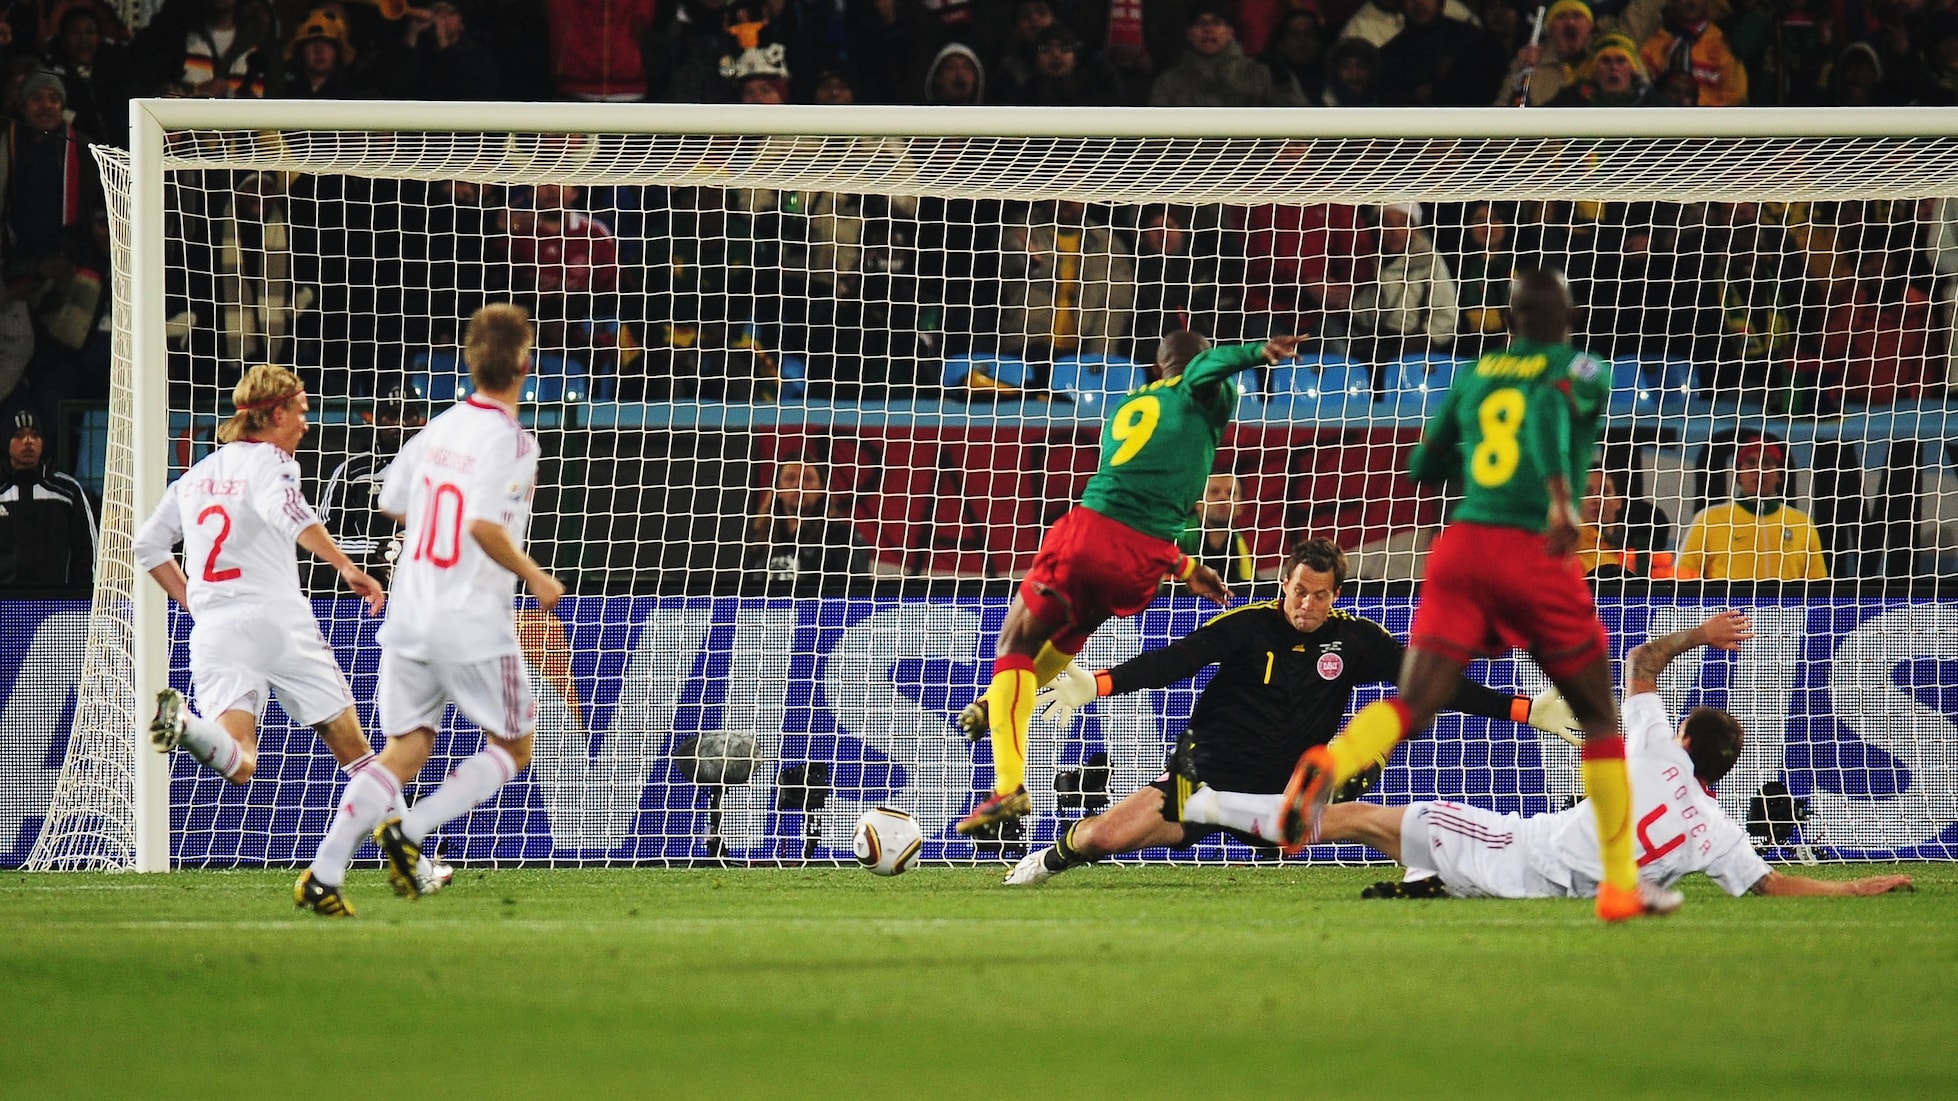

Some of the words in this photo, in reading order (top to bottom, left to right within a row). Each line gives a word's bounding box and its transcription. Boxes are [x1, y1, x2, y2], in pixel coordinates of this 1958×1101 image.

[1109, 394, 1160, 467] 9
[1471, 387, 1526, 488] 8
[197, 504, 242, 582] 2
[412, 475, 464, 569] 10
[1263, 651, 1275, 685] 1
[1634, 803, 1687, 869] 4
[1661, 765, 1712, 857] AGGER
